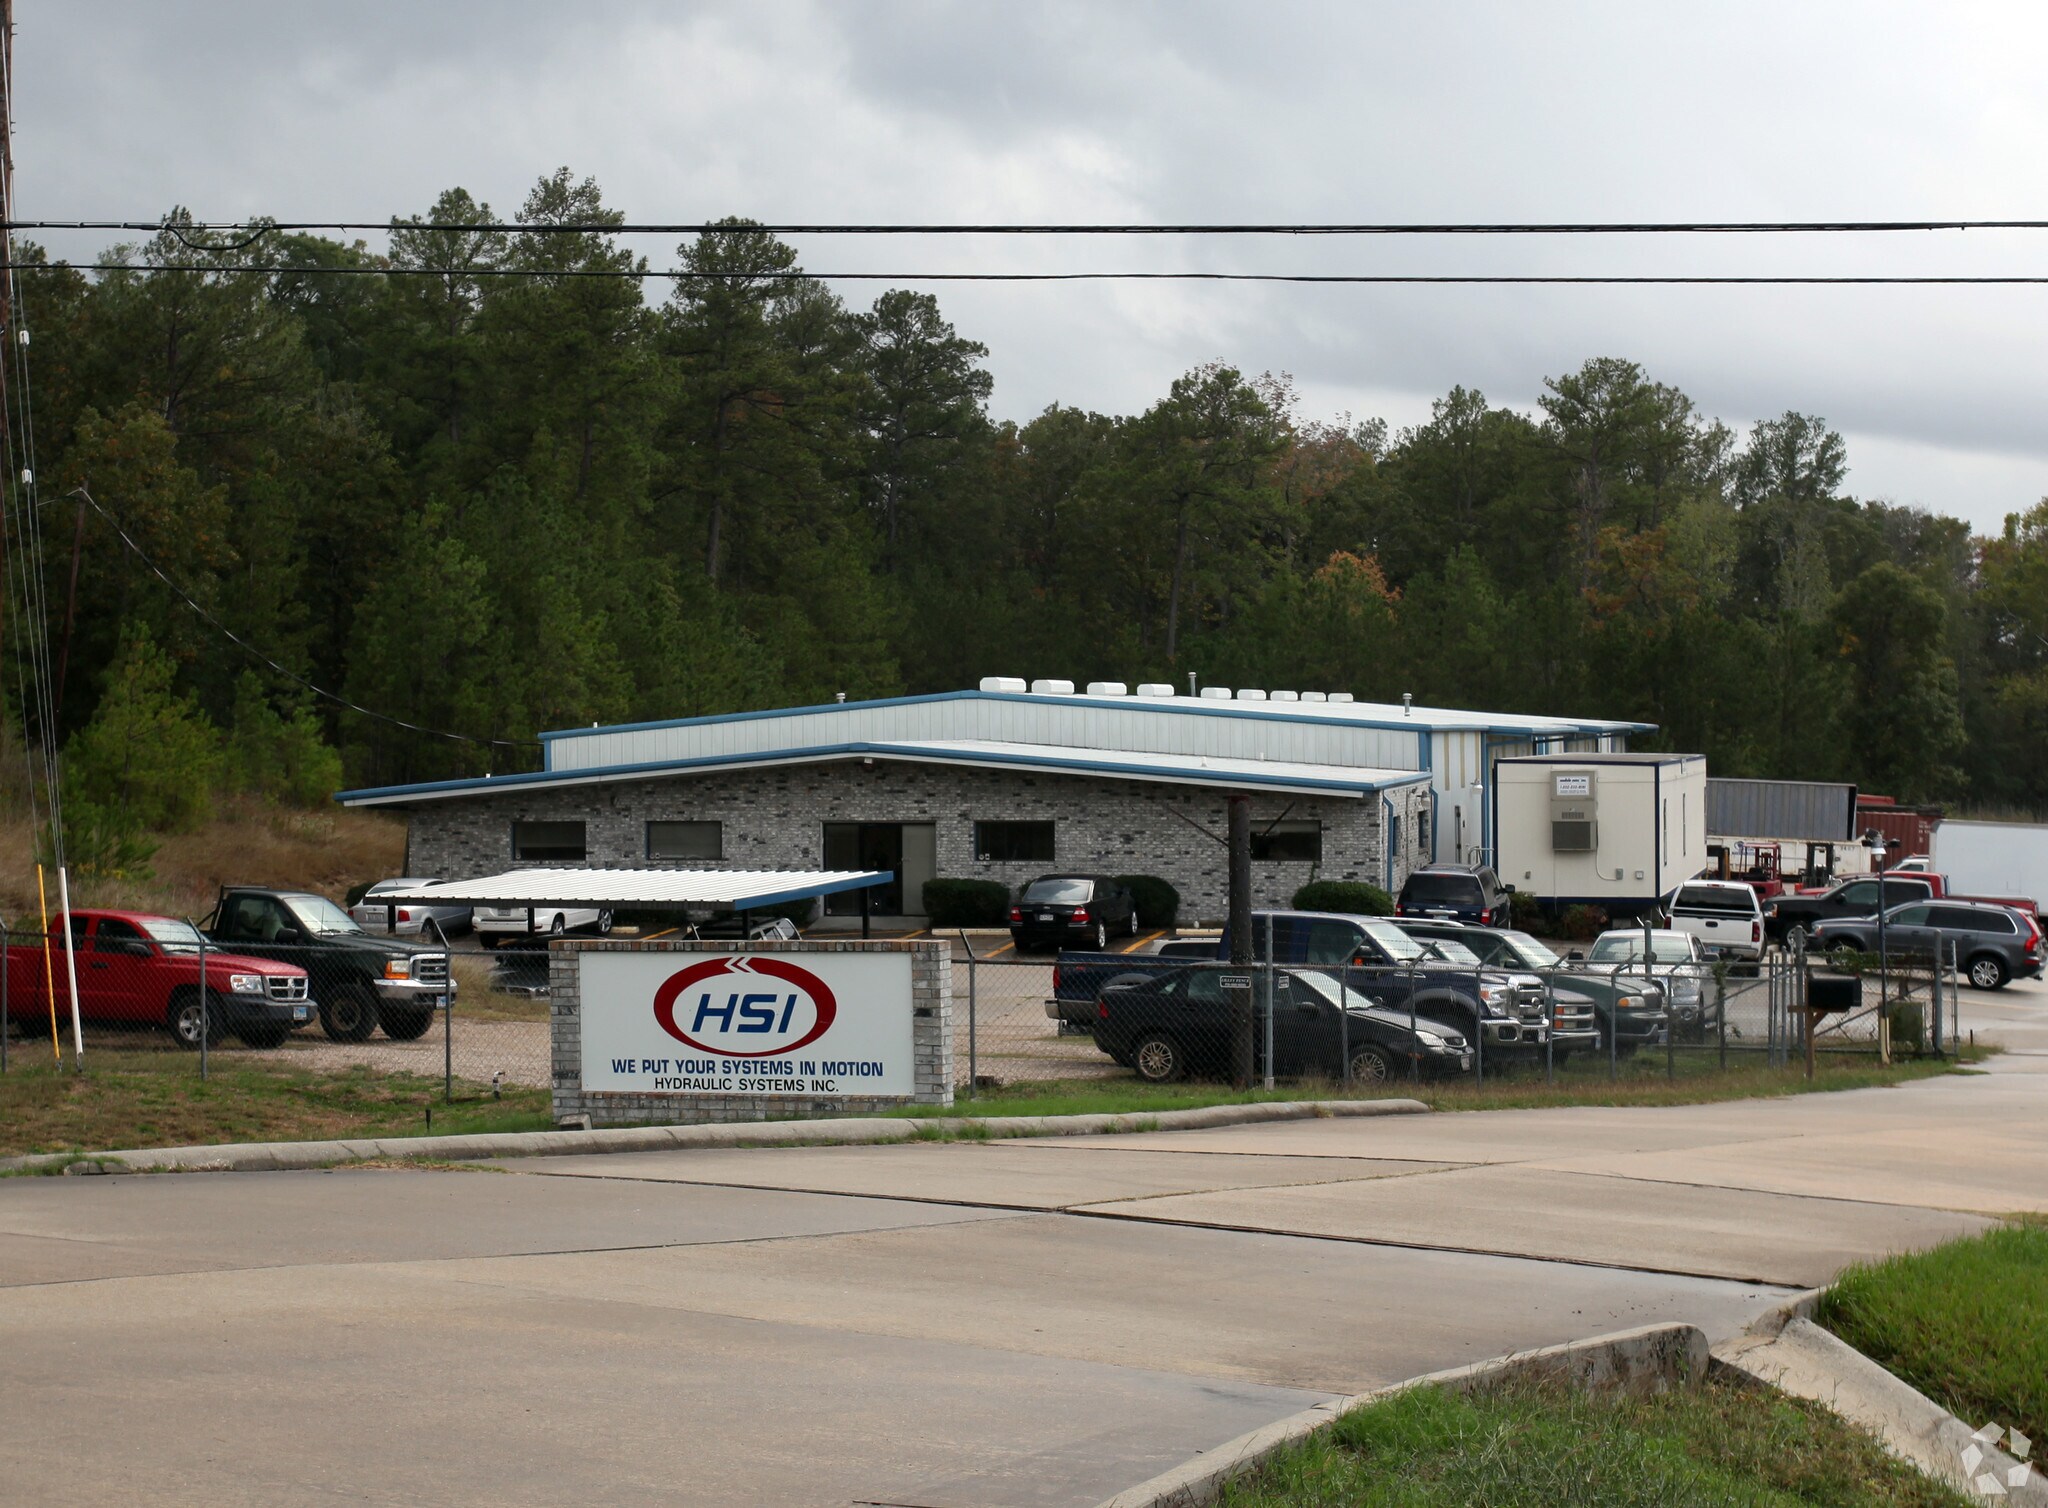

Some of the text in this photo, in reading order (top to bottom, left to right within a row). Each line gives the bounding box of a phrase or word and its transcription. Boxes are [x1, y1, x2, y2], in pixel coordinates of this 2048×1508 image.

[691, 993, 798, 1034] HSI
[611, 1058, 884, 1077] WE PUT YOUR SYSTEMS IN MOTION
[654, 1077, 839, 1093] HYDRAULIC SYSTEMS INC.
